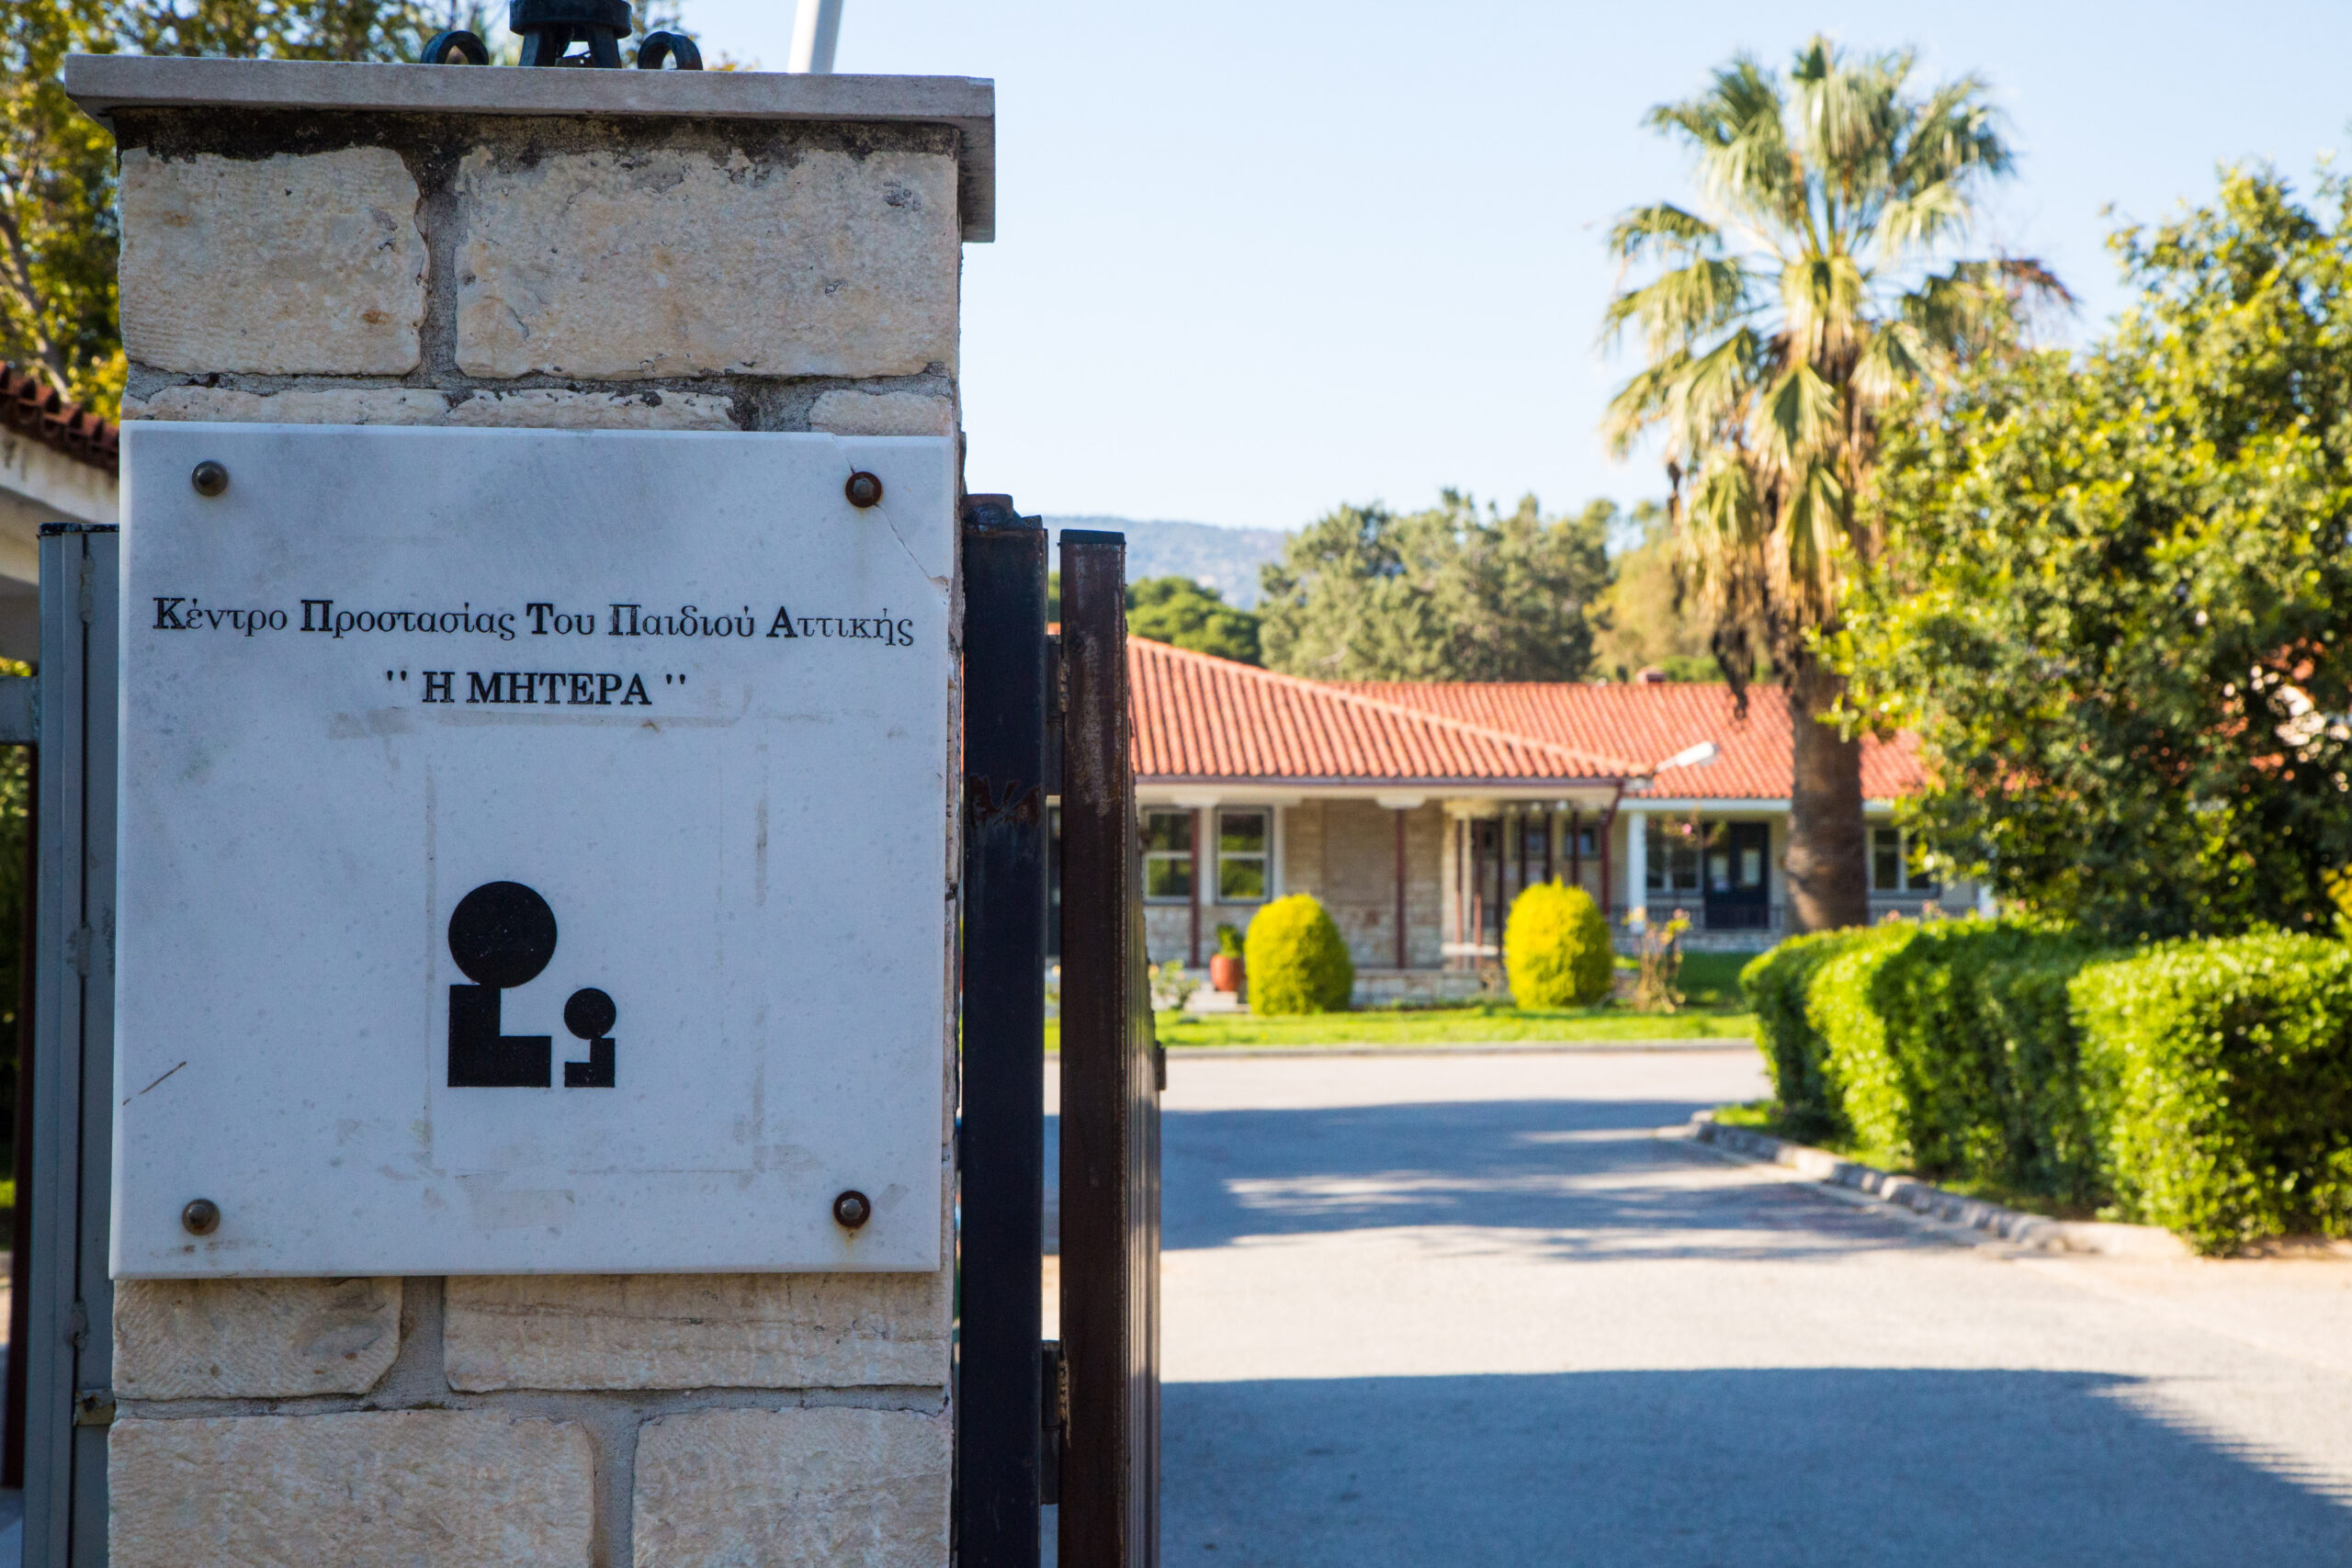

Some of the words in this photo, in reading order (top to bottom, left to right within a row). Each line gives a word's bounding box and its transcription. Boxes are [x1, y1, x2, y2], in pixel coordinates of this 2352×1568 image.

[152, 596, 288, 638] Κέντρο
[299, 598, 516, 642] Προστασίας
[526, 602, 595, 636] Του
[607, 603, 755, 637] Παιδιού
[765, 605, 915, 647] Αττικής
